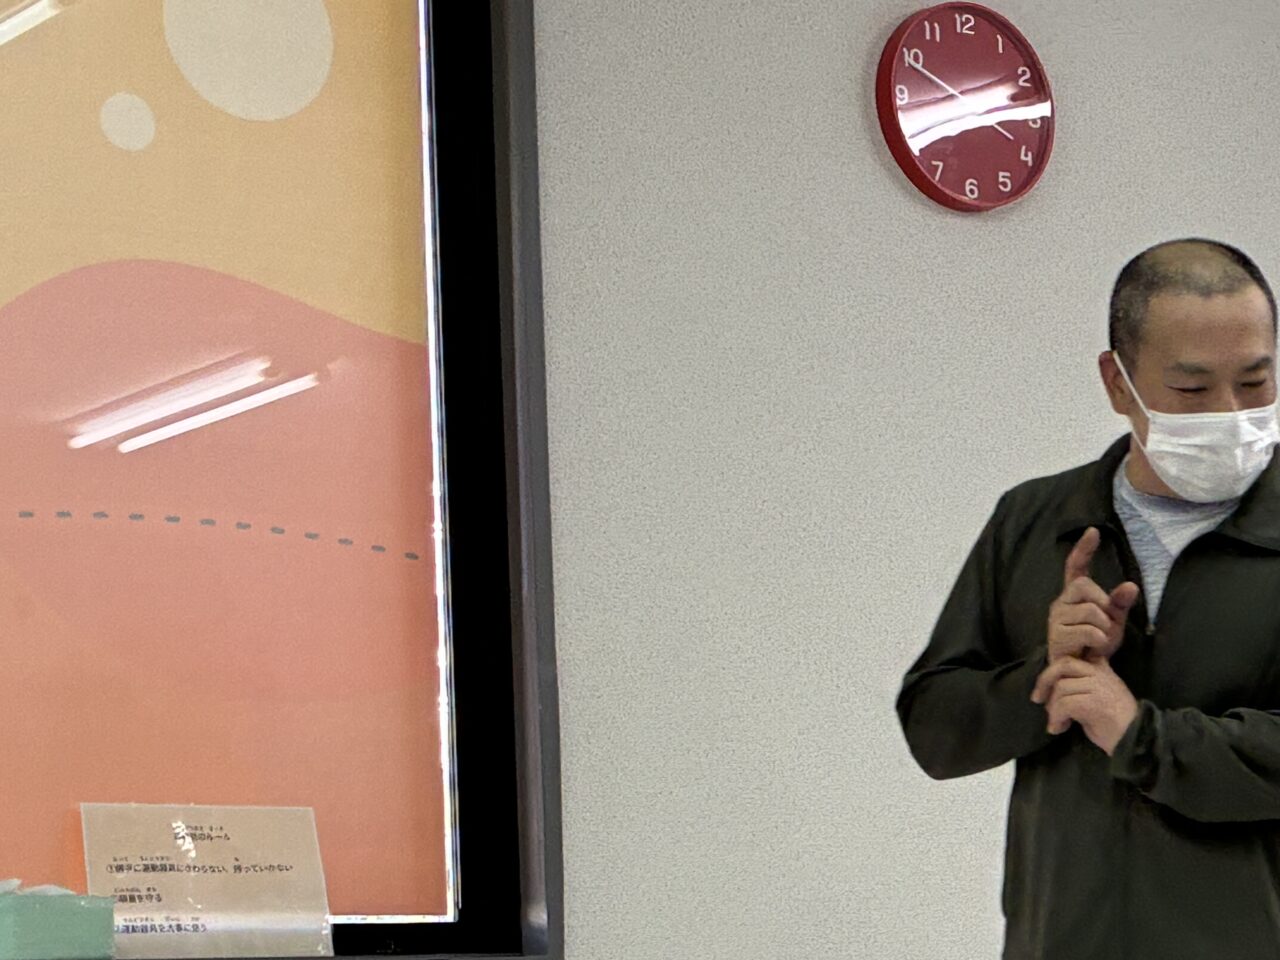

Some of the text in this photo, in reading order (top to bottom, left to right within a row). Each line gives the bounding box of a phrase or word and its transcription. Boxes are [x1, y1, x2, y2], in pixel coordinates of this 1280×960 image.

[924, 20, 941, 43] 11
[954, 13, 975, 35] 12
[996, 34, 1004, 54] 1
[902, 47, 923, 68] 10
[1017, 66, 1032, 87] 2
[895, 85, 909, 104] 9
[1020, 145, 1033, 167] 4
[931, 160, 944, 182] 7
[965, 178, 979, 199] 6
[998, 172, 1012, 192] 5
